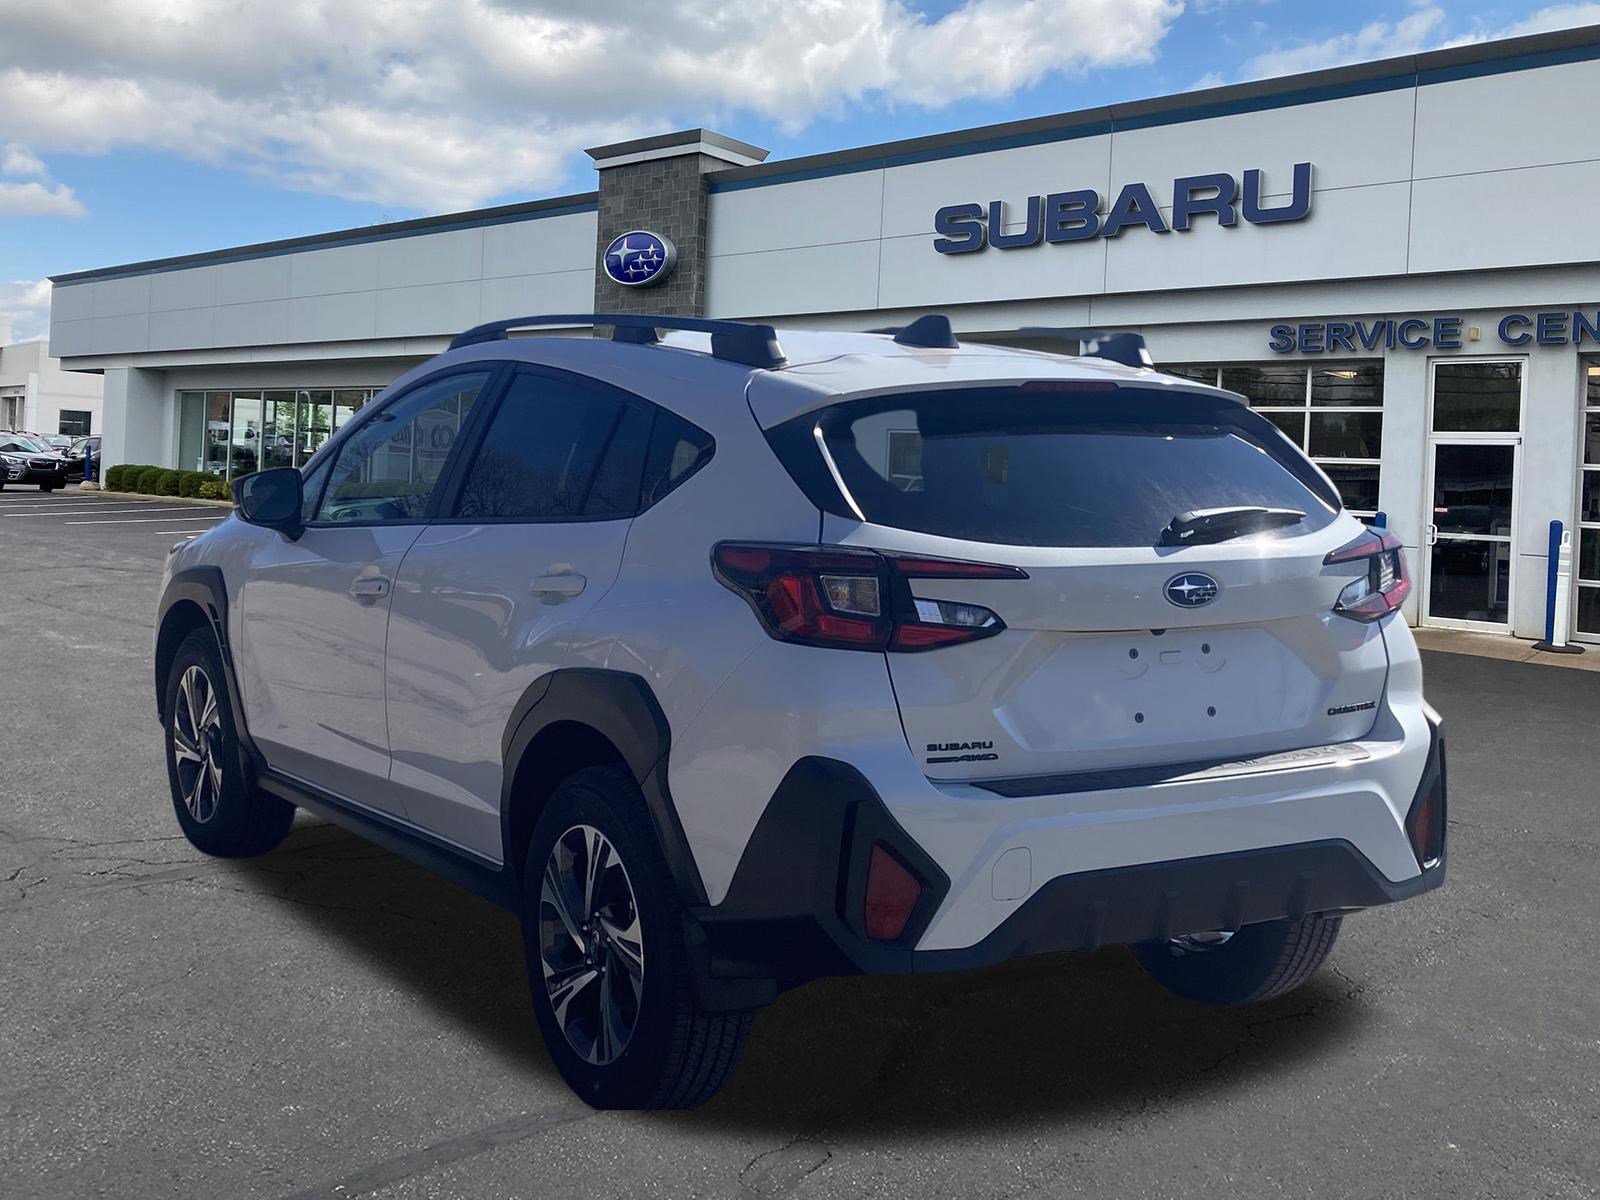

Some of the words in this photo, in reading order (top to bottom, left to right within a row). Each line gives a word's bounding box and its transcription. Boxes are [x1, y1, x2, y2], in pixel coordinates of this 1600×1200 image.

[933, 161, 1314, 255] SUBARU
[1269, 317, 1464, 353] SERVICE
[1498, 310, 1600, 346] CEN
[926, 741, 993, 752] SUBARU
